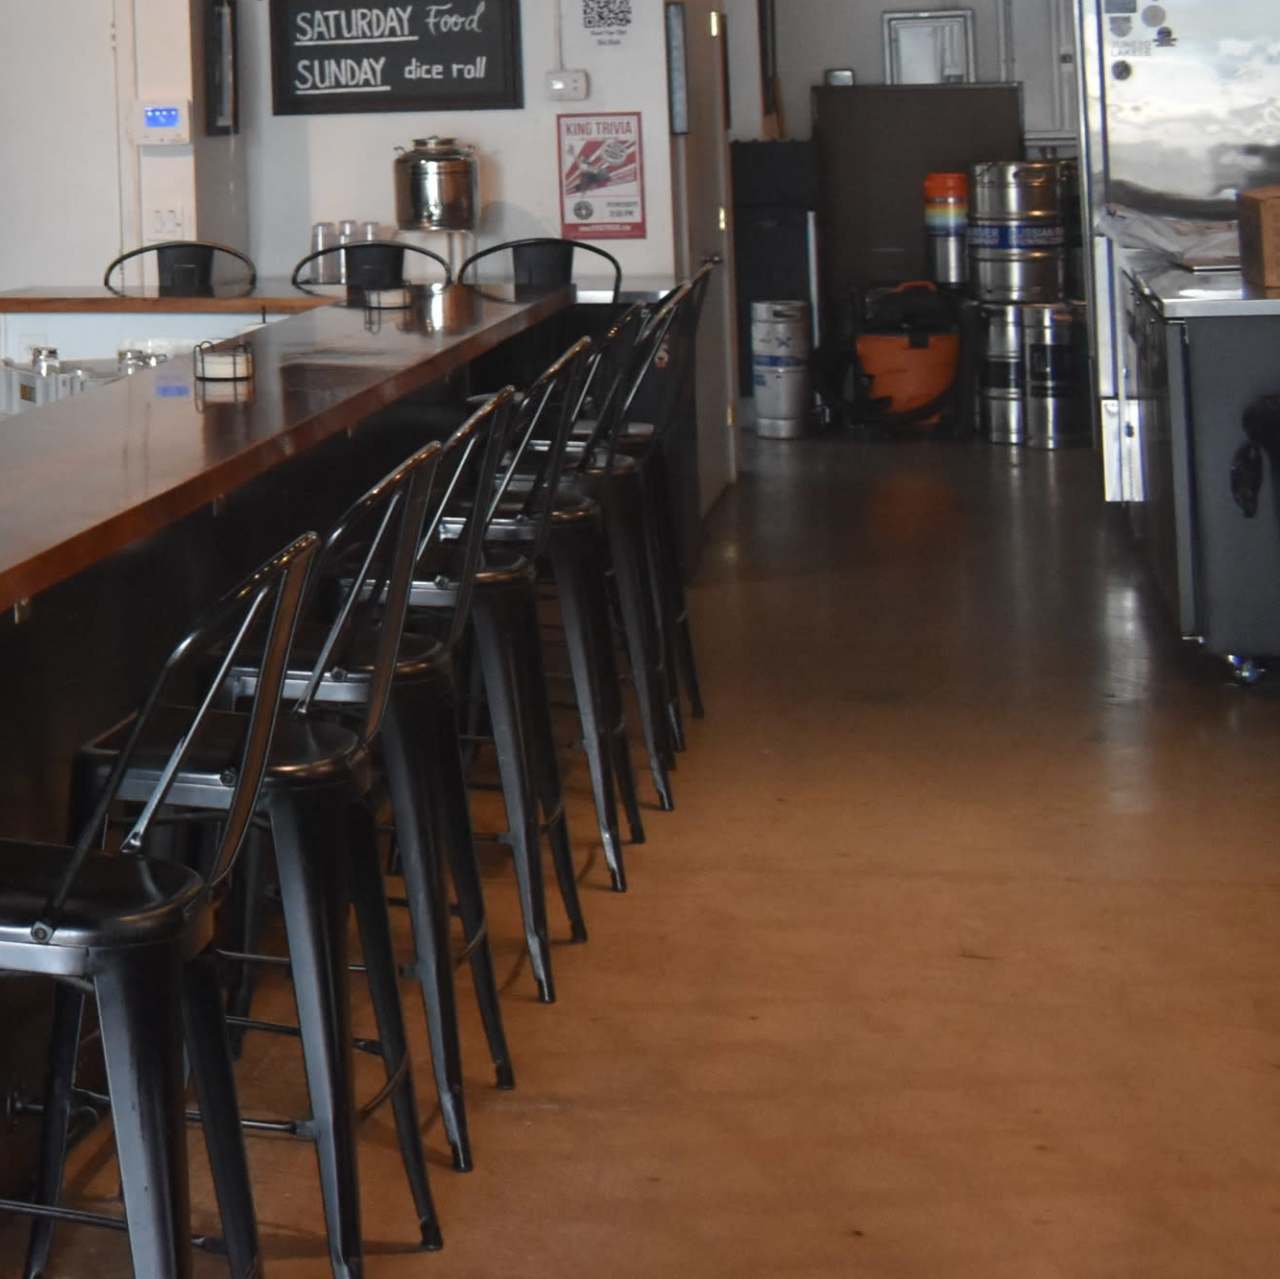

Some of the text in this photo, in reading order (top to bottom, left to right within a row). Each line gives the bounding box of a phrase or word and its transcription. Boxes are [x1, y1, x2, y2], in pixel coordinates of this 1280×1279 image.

[296, 0, 485, 41] SATURDAY Food
[296, 57, 487, 90] SUNDAY dice roll
[595, 121, 633, 135] TRIVIA
